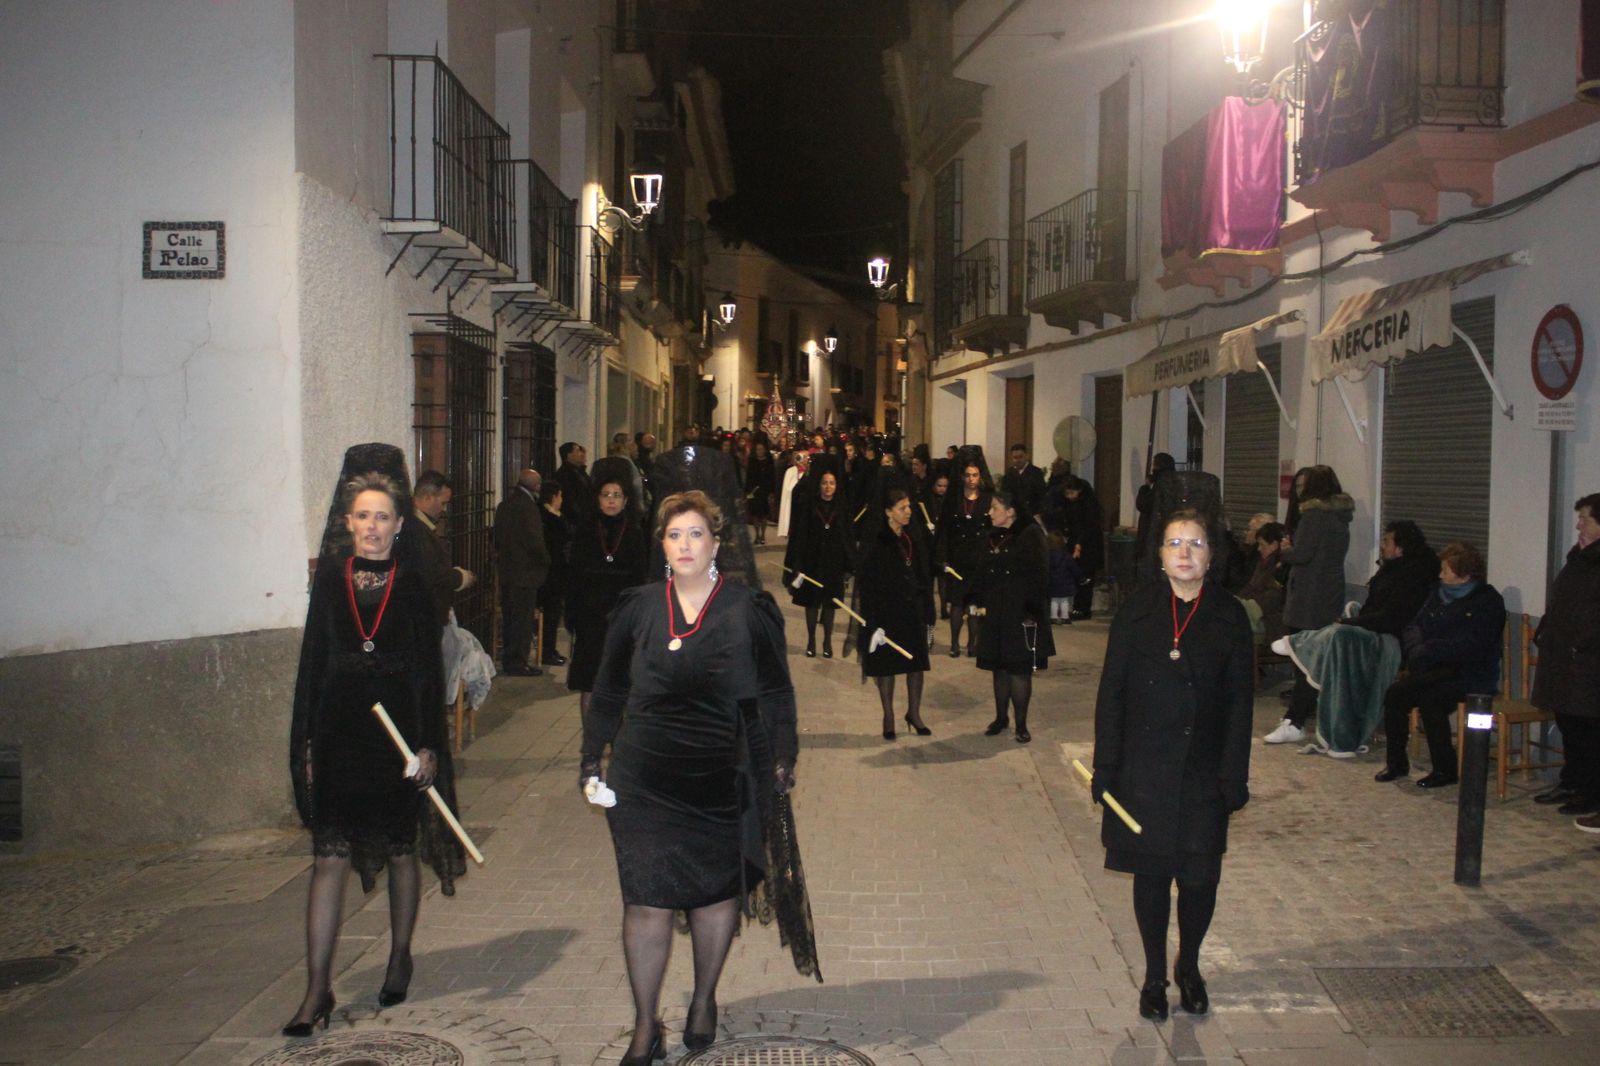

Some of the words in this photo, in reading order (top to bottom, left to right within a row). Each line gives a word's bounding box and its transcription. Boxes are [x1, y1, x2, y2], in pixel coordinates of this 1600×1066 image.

[167, 233, 203, 247] Calle
[159, 249, 209, 266] Pelao
[1331, 309, 1410, 364] MERCERIA
[1153, 347, 1210, 382] PERFUMERIA
